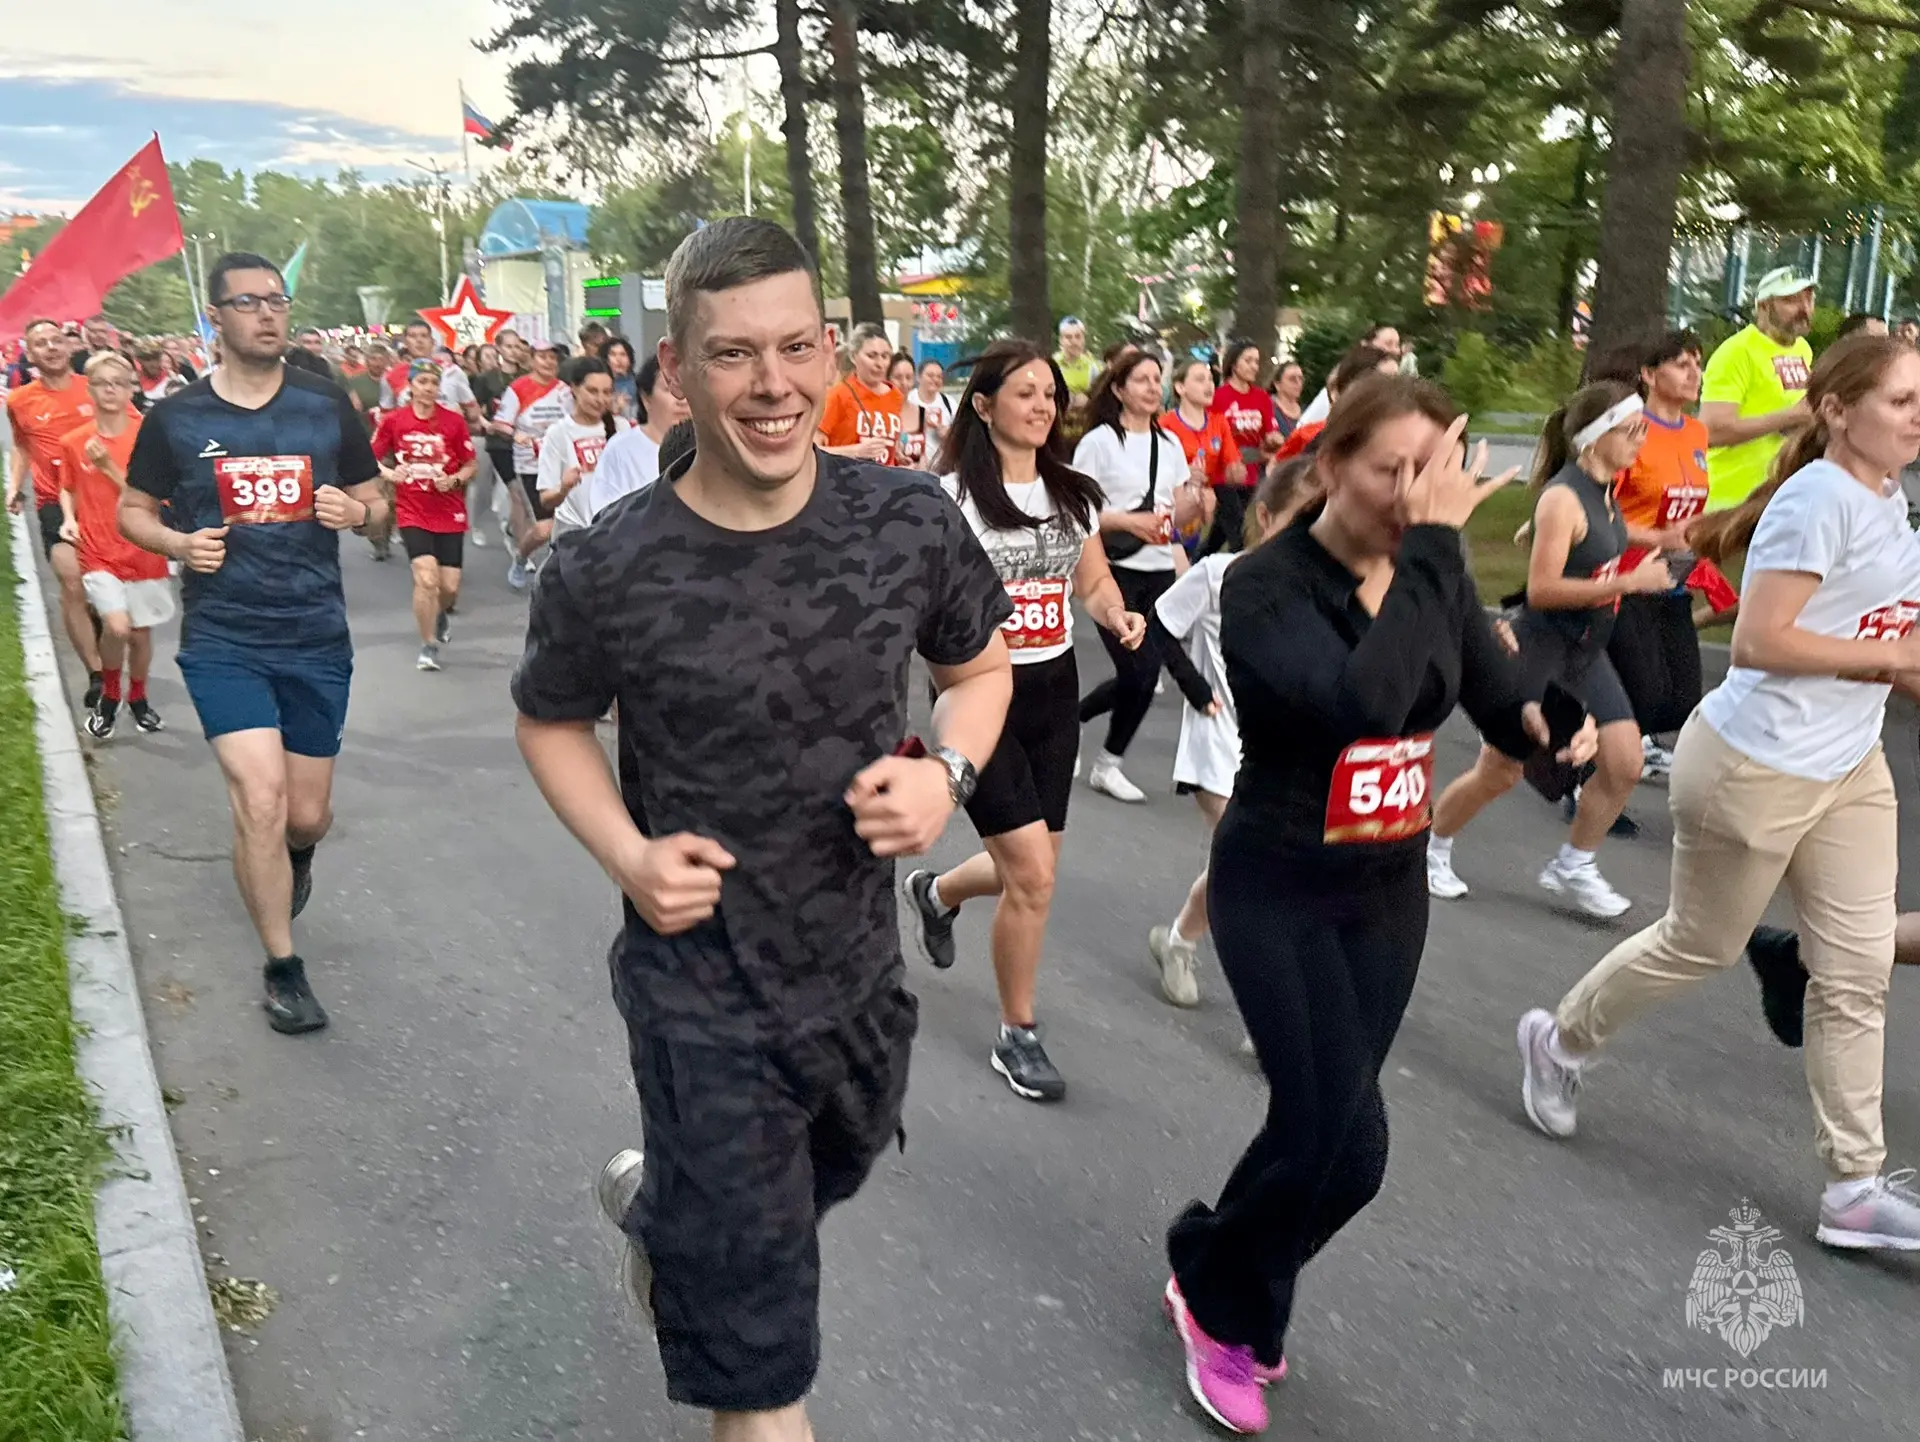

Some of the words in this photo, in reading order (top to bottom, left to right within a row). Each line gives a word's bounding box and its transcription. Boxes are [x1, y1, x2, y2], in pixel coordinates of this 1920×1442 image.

[856, 410, 901, 440] GAP
[231, 477, 301, 506] 399
[1000, 601, 1060, 632] 568
[1348, 763, 1426, 815] 540
